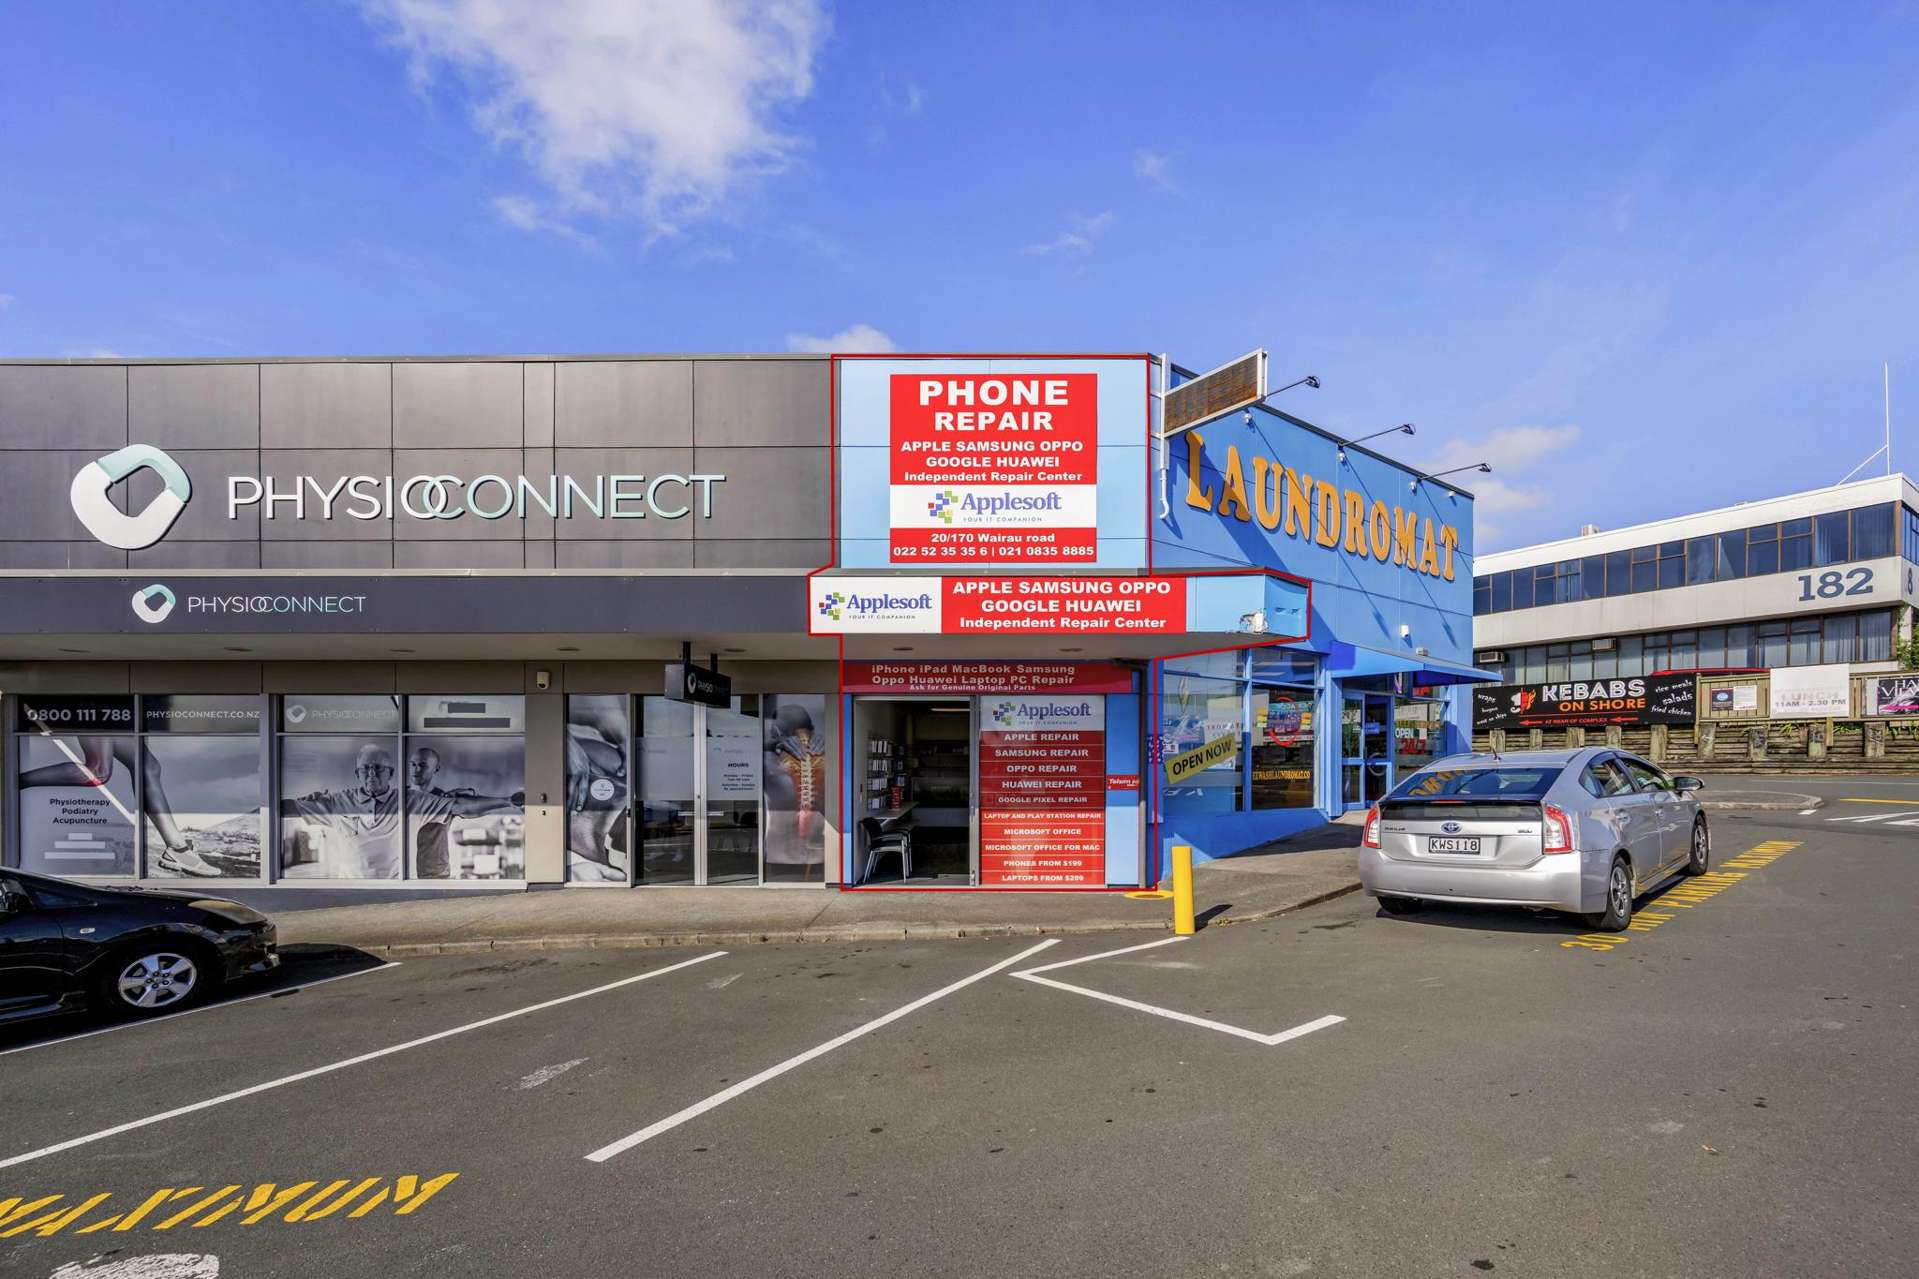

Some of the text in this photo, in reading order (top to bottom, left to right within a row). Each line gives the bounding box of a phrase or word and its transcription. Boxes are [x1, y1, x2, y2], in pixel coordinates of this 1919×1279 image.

[919, 380, 1069, 406] PHONE
[935, 411, 1053, 431] REPAIR
[901, 441, 1084, 452] APPLE SAMSUNG OPPO
[926, 457, 1060, 468] GOOGLE HUAWEI
[904, 472, 1083, 484] Independent Repair Center
[228, 475, 727, 519] PHYSIOCONNECT
[960, 492, 1063, 515] Applesoft
[1185, 431, 1458, 582] LAUNDROMAT
[931, 533, 1056, 543] 20/170 Wairau road
[893, 547, 917, 557] 022
[921, 547, 937, 557] 52
[941, 547, 956, 557] 35
[960, 547, 976, 557] 35
[980, 547, 989, 557] 6
[999, 547, 1022, 557] 021
[1026, 547, 1058, 557] 0835
[1062, 547, 1094, 557] 8885
[952, 582, 1171, 594] APPLE SAMSUNG OPPO
[1798, 567, 1874, 601] 182
[188, 596, 367, 613] PHYSIOCONNECT
[847, 593, 933, 613] Applesoft
[981, 600, 1141, 613] GOOGLE HUAWEI
[960, 617, 1167, 631] Independent Repair Center
[871, 664, 1076, 676] iPhone iPad MacBook Samsung
[871, 675, 1075, 686] Oppo Huawei Laptop PC Repair
[978, 684, 1011, 692] Original
[1542, 679, 1646, 702] KEBABS
[1663, 691, 1693, 706] salads
[1560, 698, 1646, 712] ON SHORE
[1651, 705, 1692, 716] fried chicken
[27, 709, 131, 721] 0800 111 788
[146, 710, 260, 719] PHYSIOCONNECT.CO.NZ
[1017, 703, 1091, 720] Applesoft
[1004, 733, 1080, 741] APPLE REPAIR
[1395, 728, 1414, 738] OPEN
[995, 749, 1089, 757] SAMSUNG REPAIR
[1173, 739, 1232, 775] OPEN NOW
[1006, 765, 1077, 773] OPPO REPAIR
[1002, 781, 1082, 789] HUAWEI REPAIR
[49, 798, 111, 807] Physiotherapy
[62, 808, 98, 816] Podiatry
[53, 817, 108, 825] Acupuncture
[1431, 840, 1479, 851] KWS118
